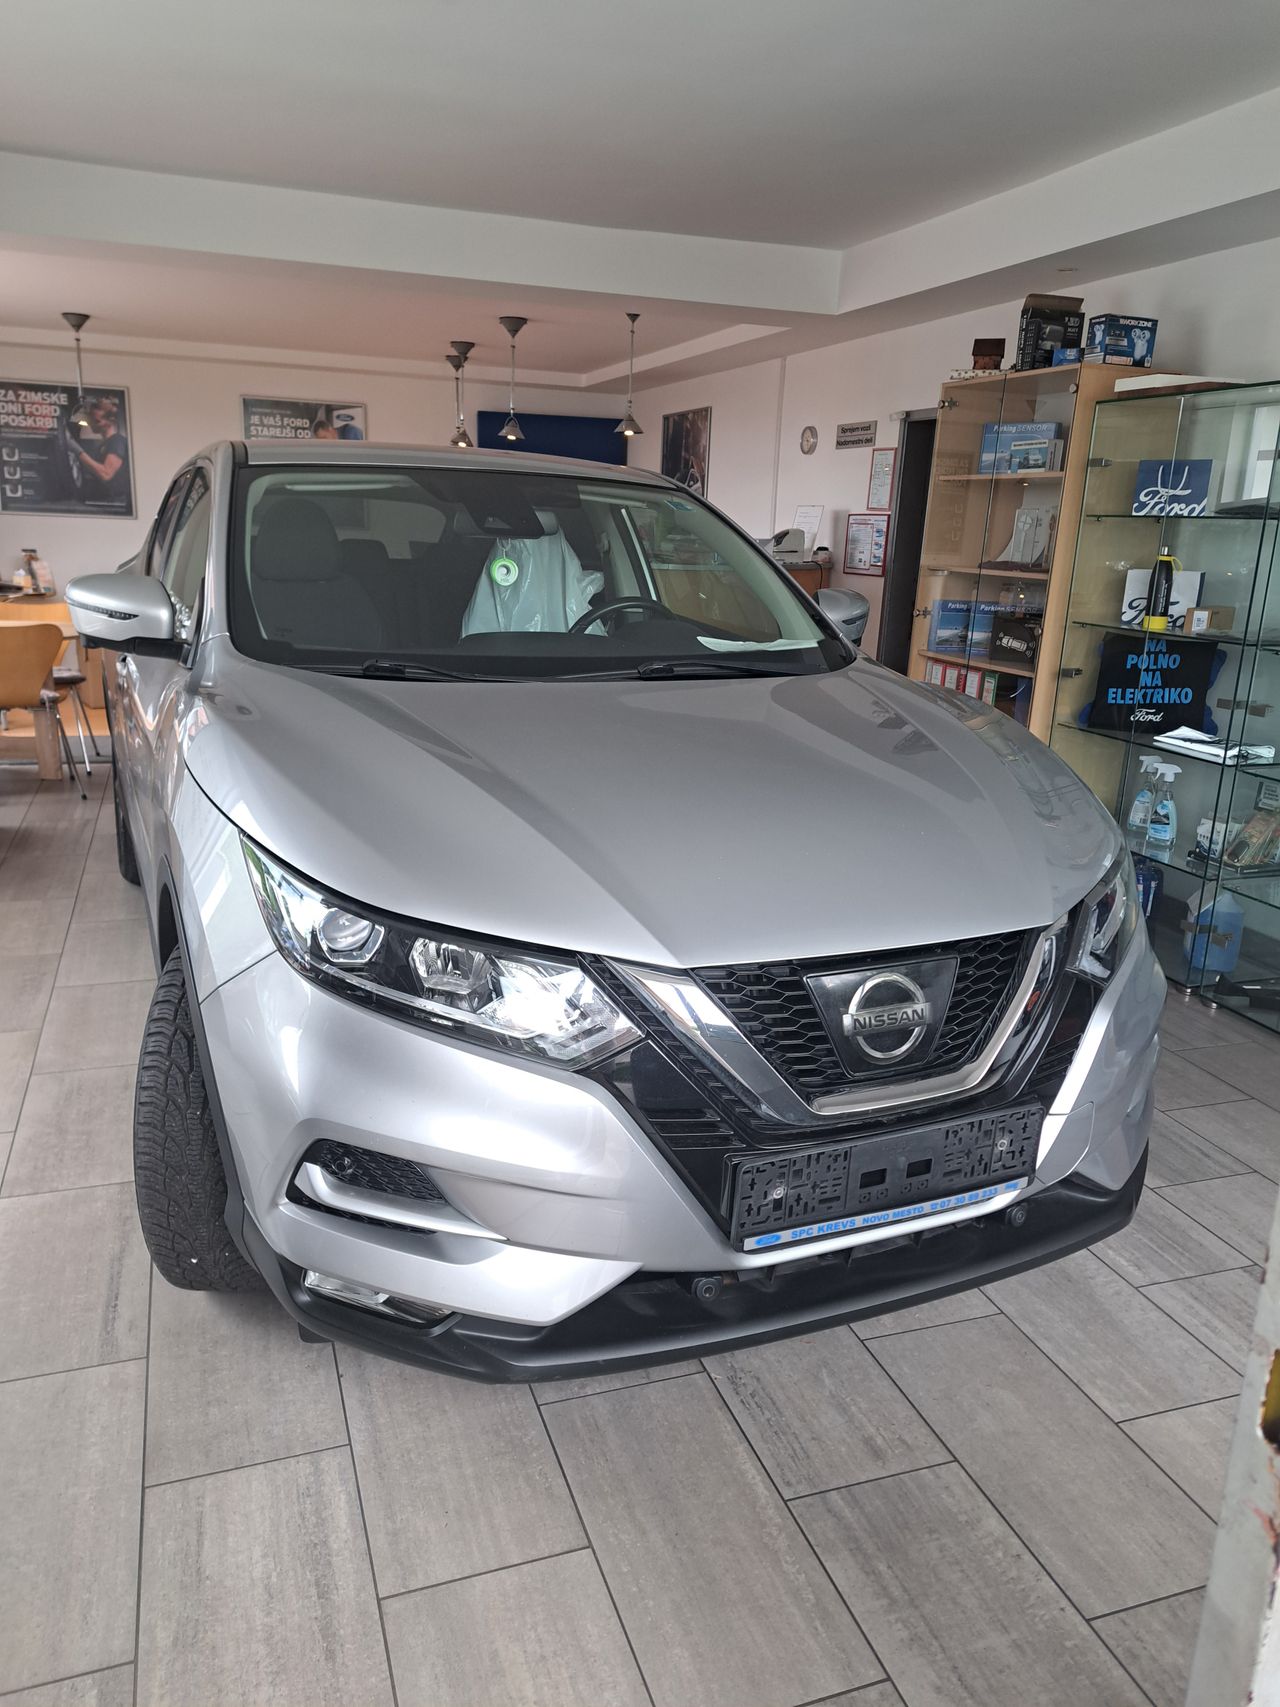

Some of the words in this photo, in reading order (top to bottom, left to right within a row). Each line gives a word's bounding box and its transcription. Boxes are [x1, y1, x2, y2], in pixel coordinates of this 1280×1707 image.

[0, 389, 16, 401] ZA
[18, 390, 68, 405] ZIMSKE
[0, 402, 21, 415] DNI
[24, 403, 60, 417] FORD
[0, 414, 57, 429] POSKRBI
[262, 414, 281, 426] VAŠ
[283, 417, 310, 428] FORD
[250, 425, 295, 438] STAREJŠI
[296, 429, 311, 439] OD
[1132, 487, 1208, 516] Ford
[1126, 654, 1181, 670] POLNO
[1140, 671, 1162, 687] NA
[1107, 687, 1193, 705] ELEKTRIKO
[1130, 708, 1164, 722] Ford
[853, 1008, 925, 1031] NISSAN
[791, 1227, 814, 1240] SPC
[817, 1219, 856, 1235] KREVS
[862, 1213, 890, 1225] NOVO
[892, 1206, 925, 1219] MESTO
